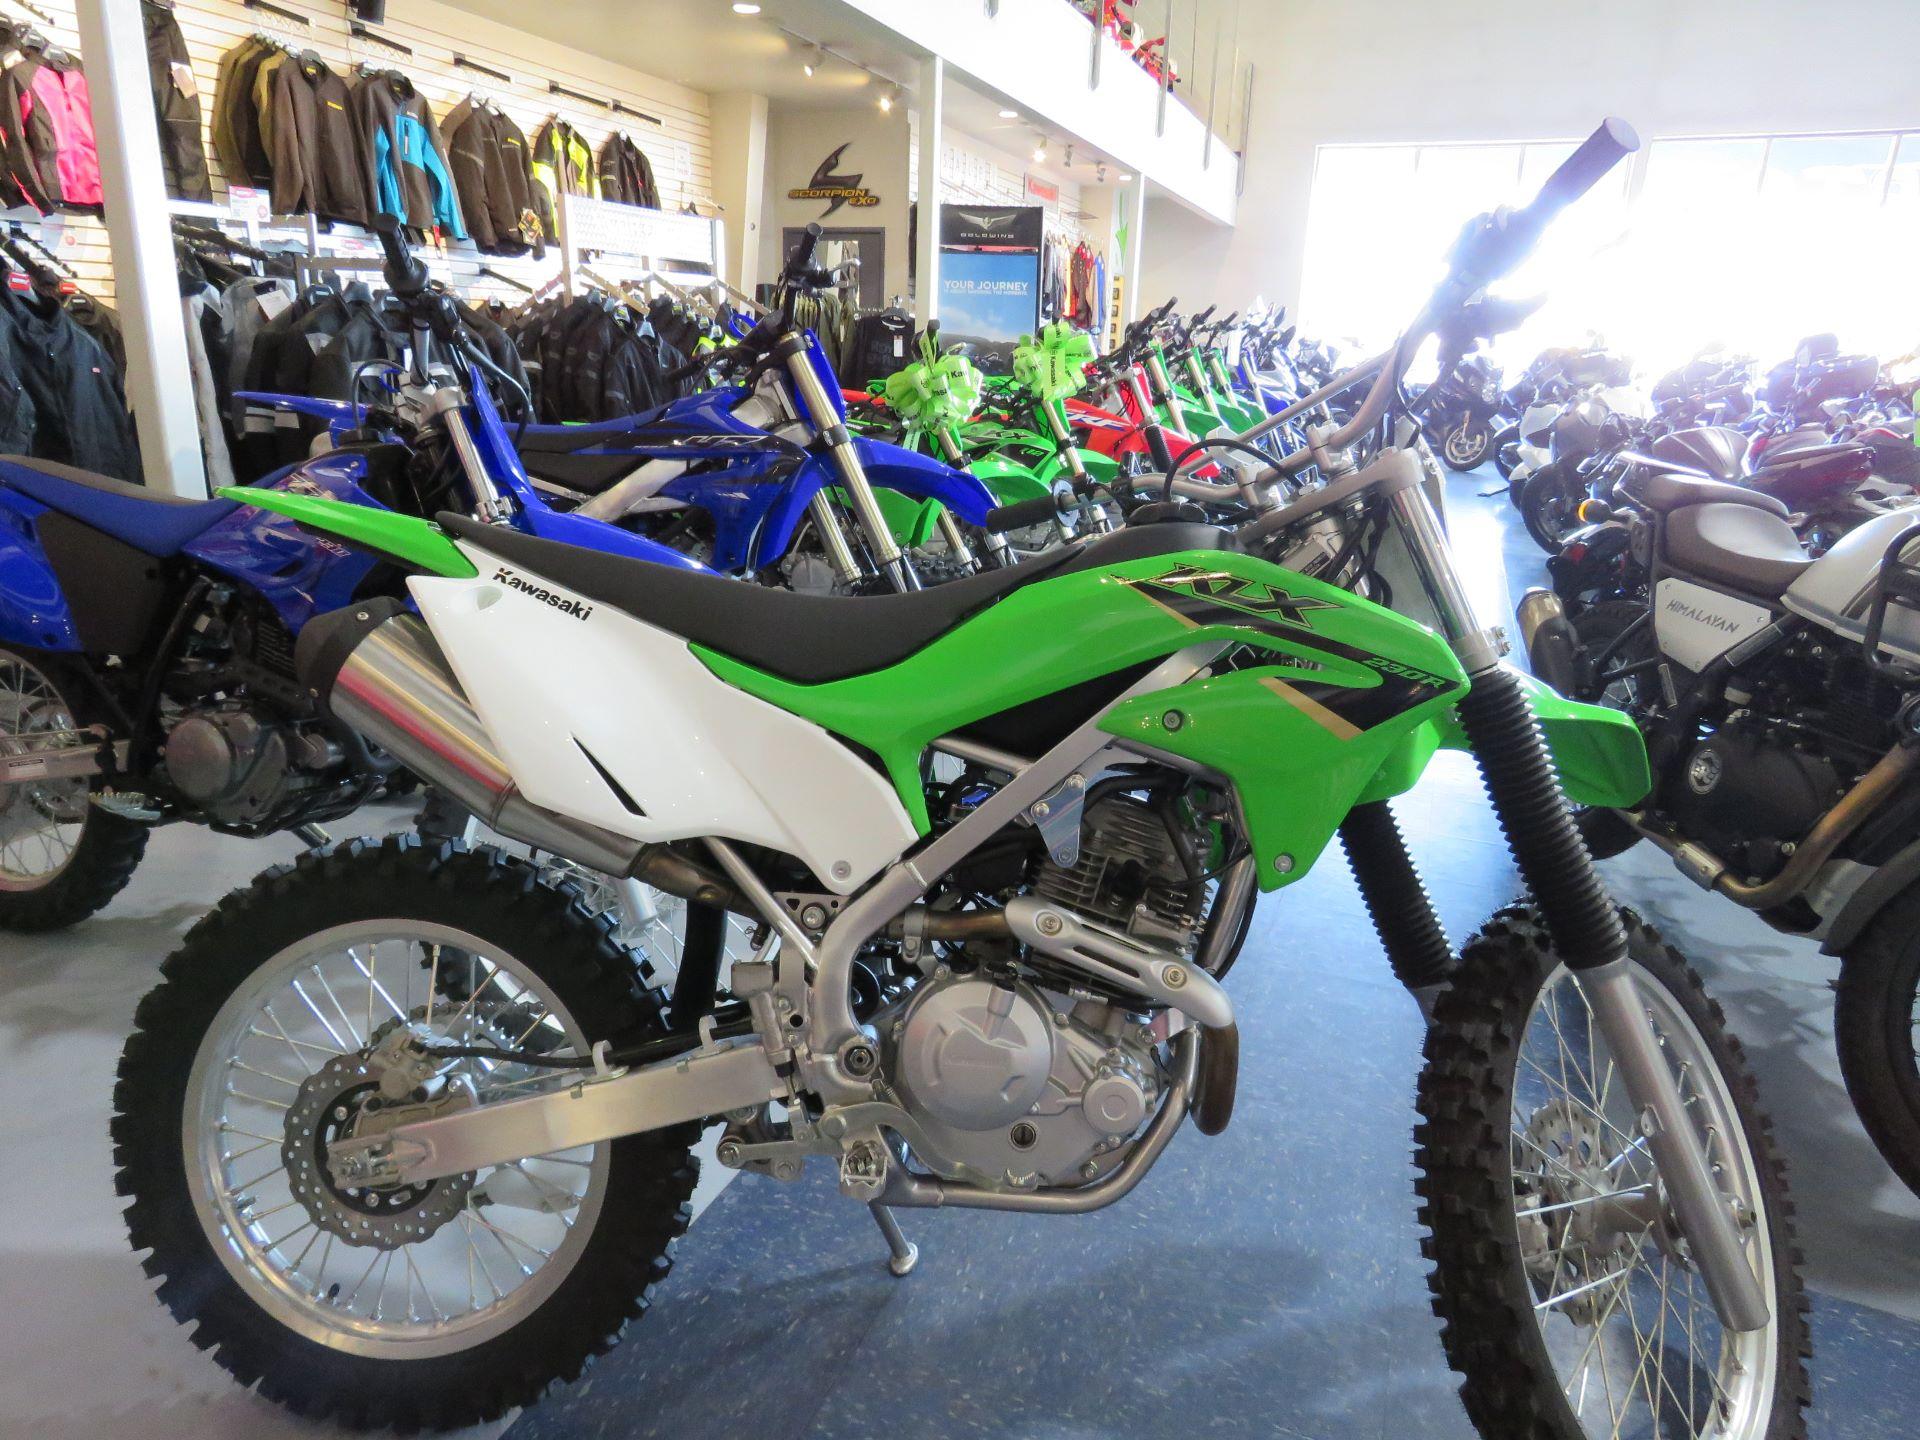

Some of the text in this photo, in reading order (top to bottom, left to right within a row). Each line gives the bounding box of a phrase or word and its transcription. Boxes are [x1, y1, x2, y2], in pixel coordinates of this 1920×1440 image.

[789, 189, 866, 198] SCORPION
[943, 280, 1029, 291] YOUR JOURNEY
[492, 567, 594, 621] Kawasaki
[1665, 599, 1740, 633] HIMALAYAN
[1362, 657, 1446, 689] 230R
